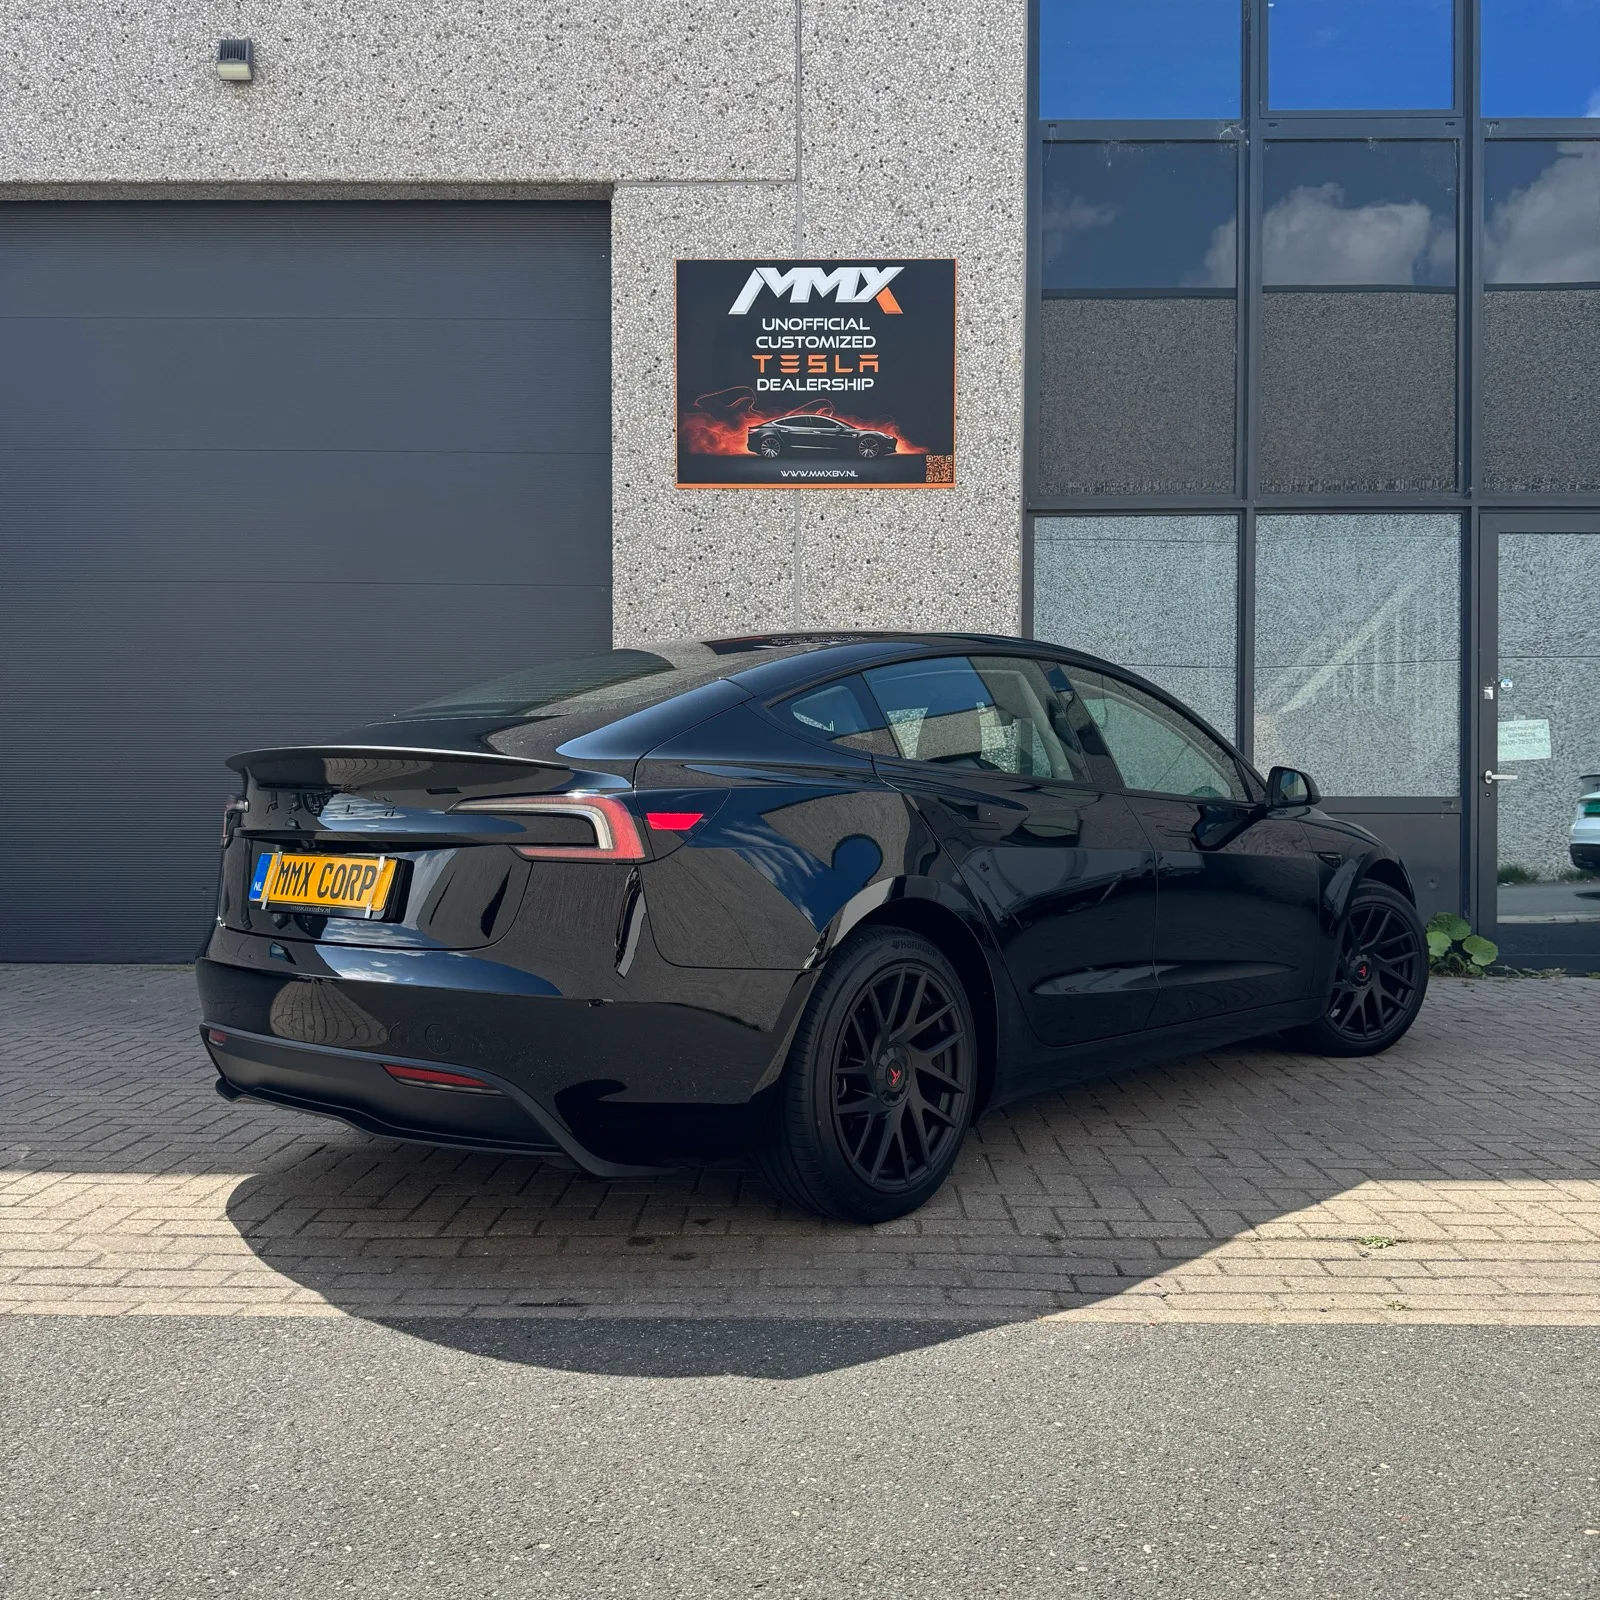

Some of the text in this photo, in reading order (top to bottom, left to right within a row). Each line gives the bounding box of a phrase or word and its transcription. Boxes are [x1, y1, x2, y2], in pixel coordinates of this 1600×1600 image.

[728, 266, 905, 315] MMX
[762, 317, 870, 331] UNOFFICIAL
[755, 335, 877, 349] CUSTOMIZED
[751, 354, 879, 373] TESLA
[756, 378, 875, 391] DEALERSHIP
[780, 470, 859, 478] WWW.MMXBV.NL
[253, 881, 262, 892] NL
[273, 861, 377, 901] MMX CORP
